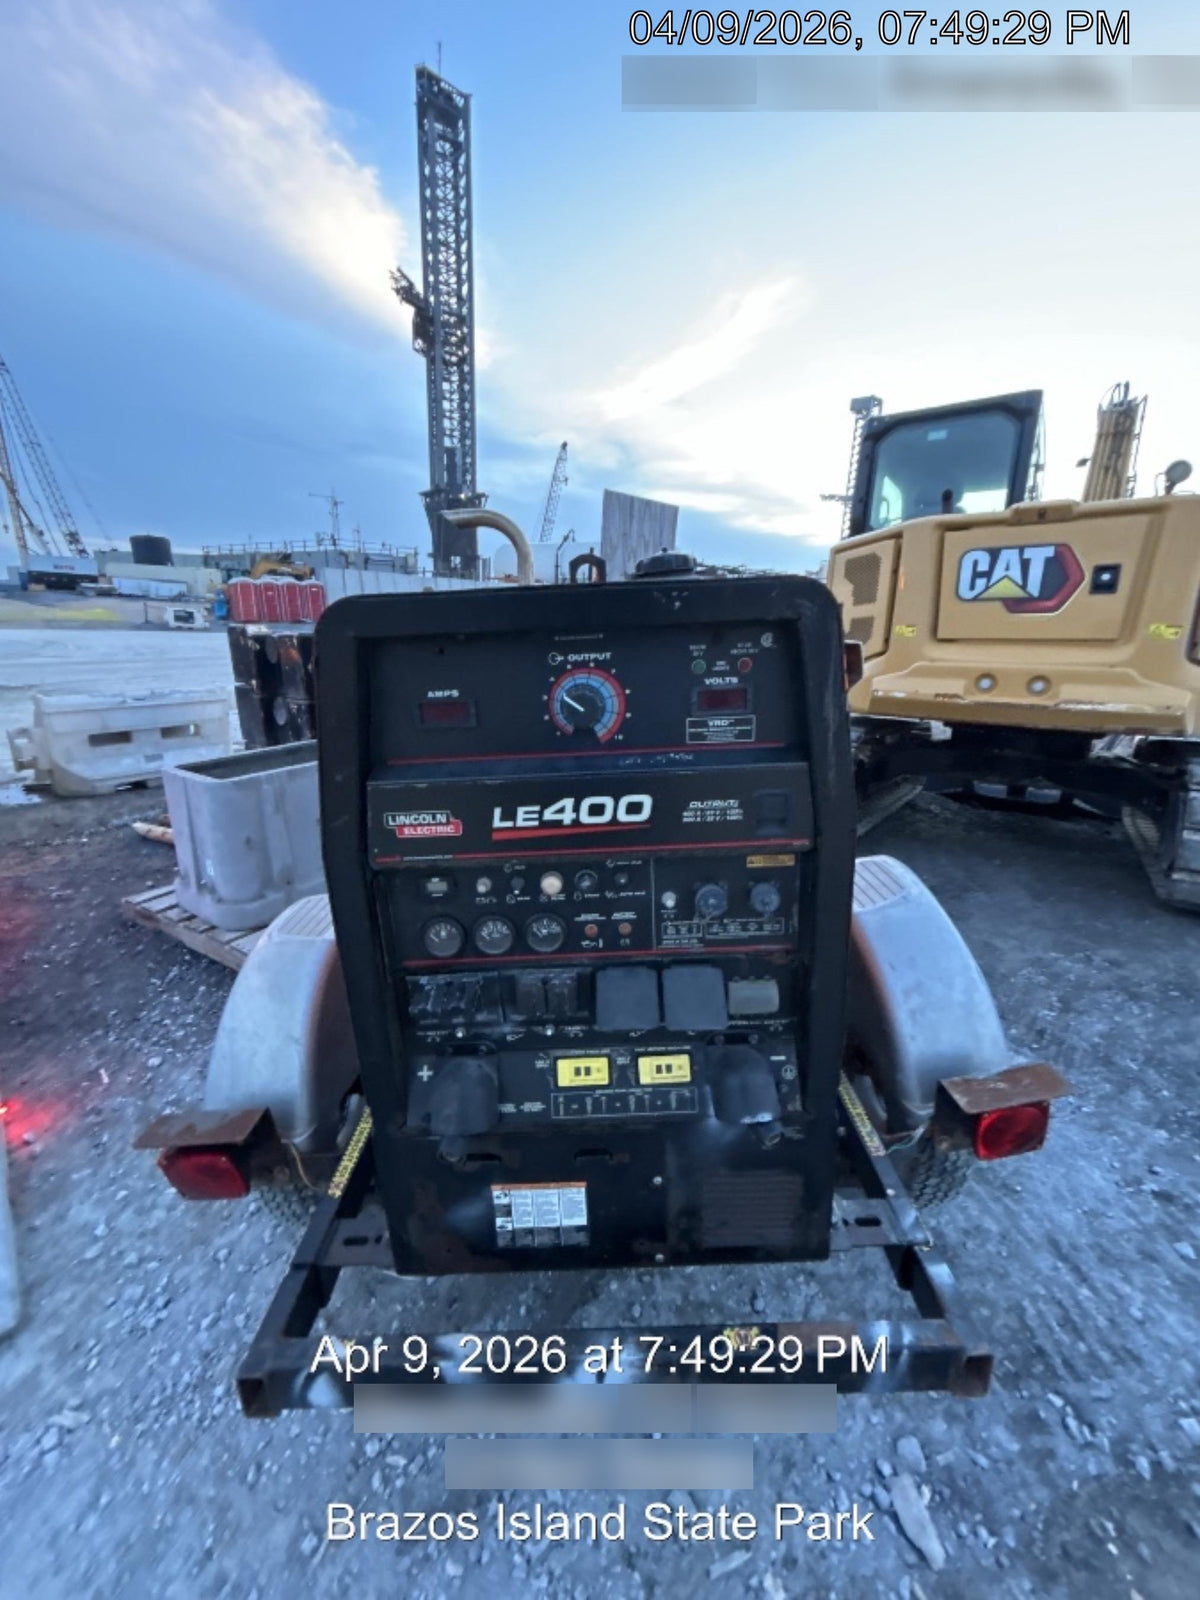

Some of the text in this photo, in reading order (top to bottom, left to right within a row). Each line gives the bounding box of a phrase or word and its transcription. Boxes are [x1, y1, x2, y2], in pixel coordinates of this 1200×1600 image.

[959, 545, 1056, 600] CAT
[567, 652, 612, 661] OUTPUT
[704, 677, 739, 685] VOLTS
[427, 689, 460, 698] AMPS
[493, 794, 653, 828] LE400
[388, 812, 448, 827] LINCOLN
[403, 824, 456, 835] ELECTRIC
